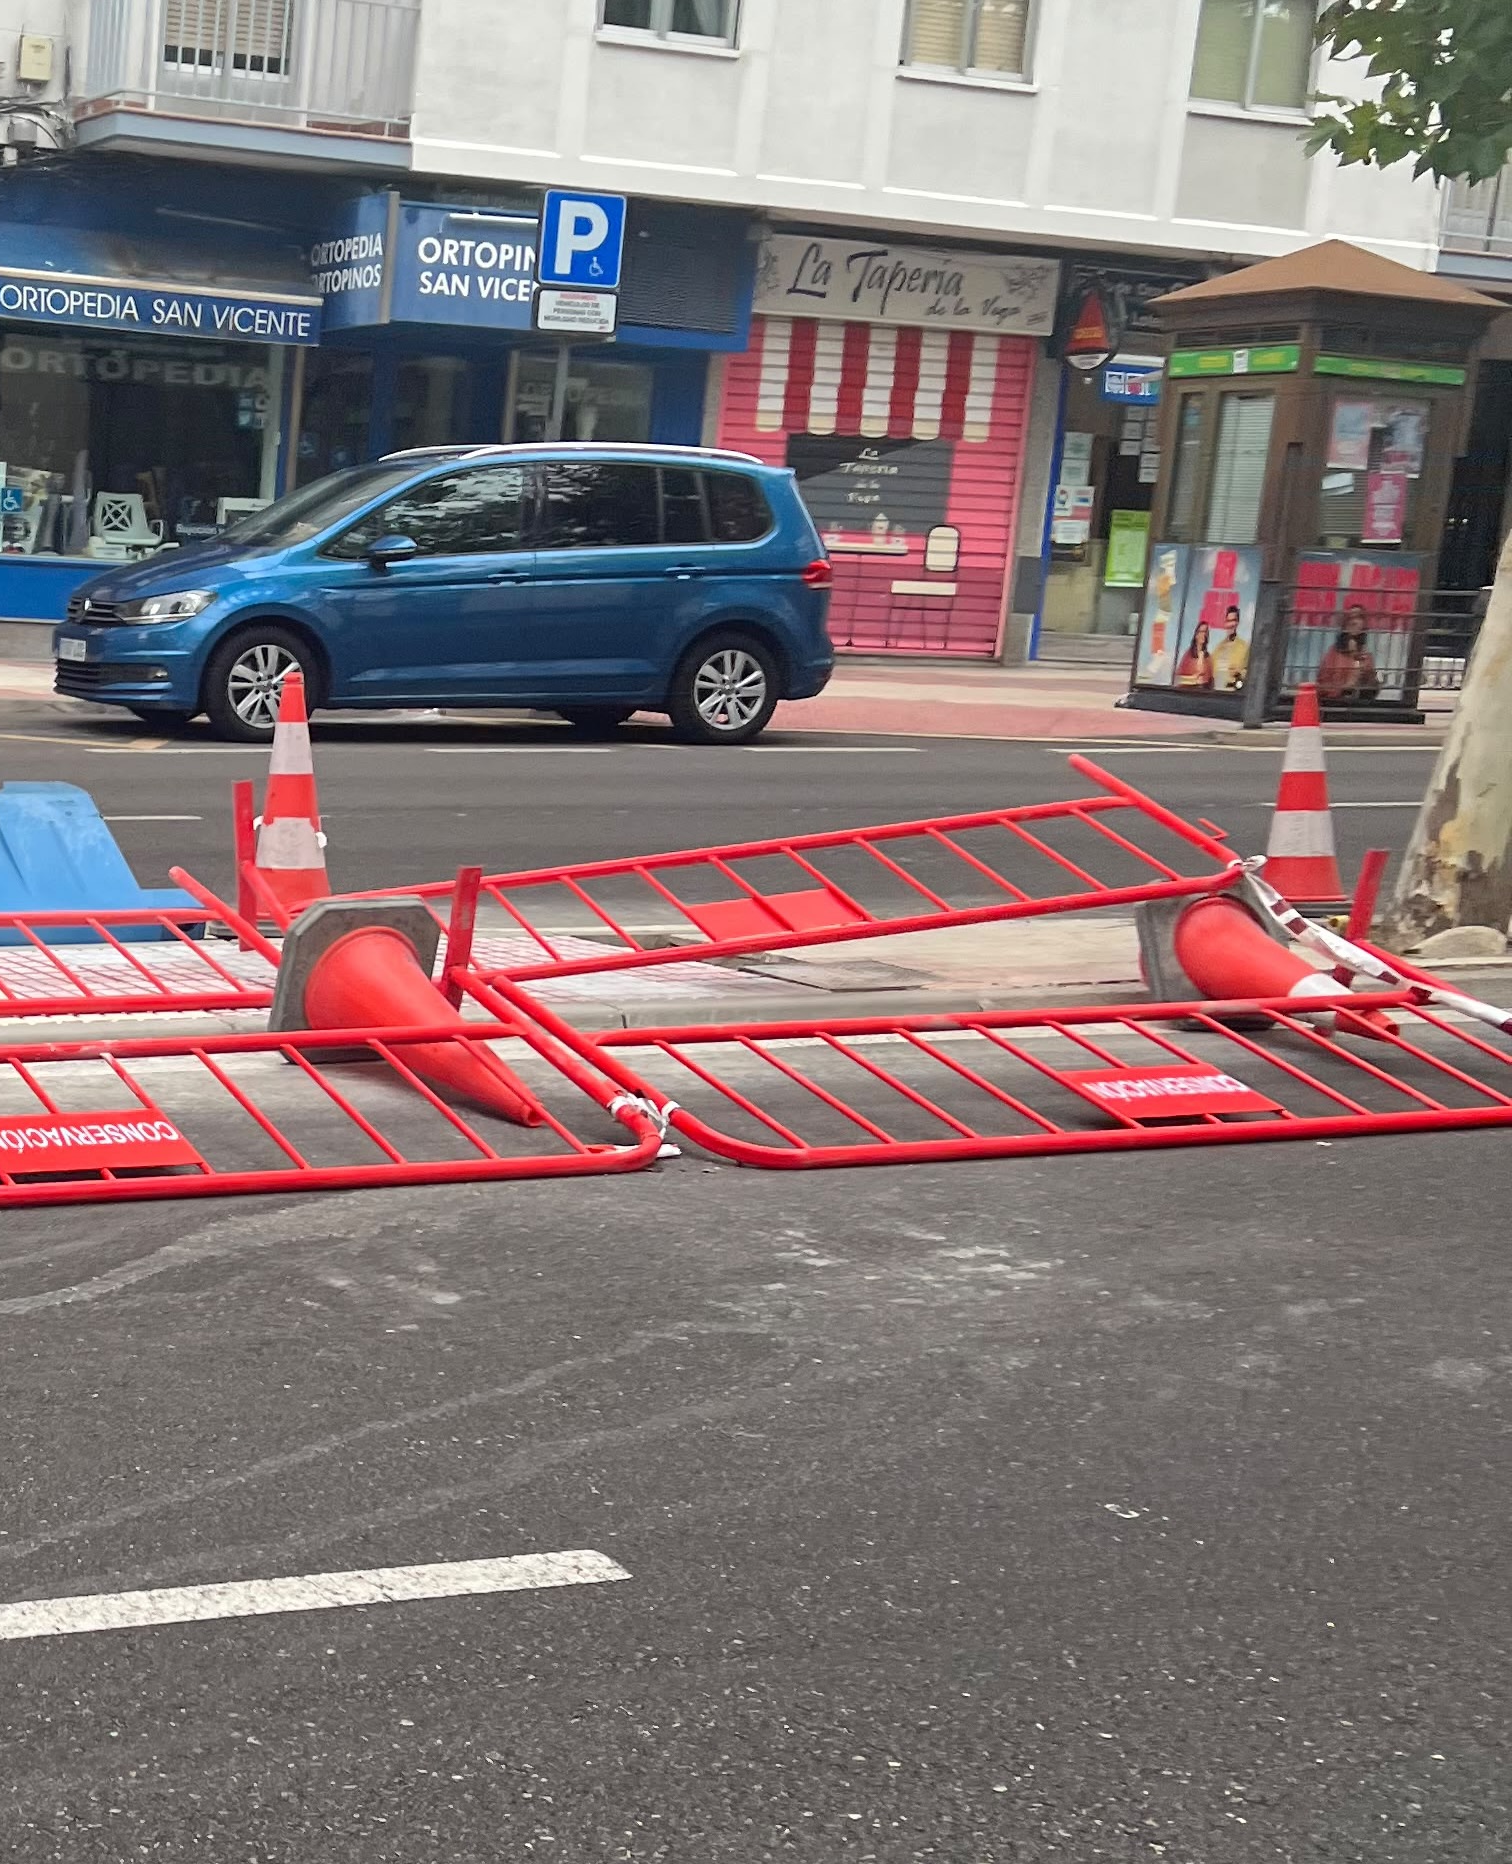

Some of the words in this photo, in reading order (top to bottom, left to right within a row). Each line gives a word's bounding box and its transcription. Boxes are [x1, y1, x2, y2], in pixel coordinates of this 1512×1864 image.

[311, 232, 384, 267] ORTOPEDIA
[417, 236, 536, 272] ORTOPIN
[554, 199, 609, 275] P
[419, 271, 470, 298] SAN
[477, 275, 540, 302] VICE
[786, 243, 832, 298] La
[0, 284, 139, 321] ORTOPEDIA
[152, 299, 202, 328] SAN
[212, 304, 311, 338] VICENTE
